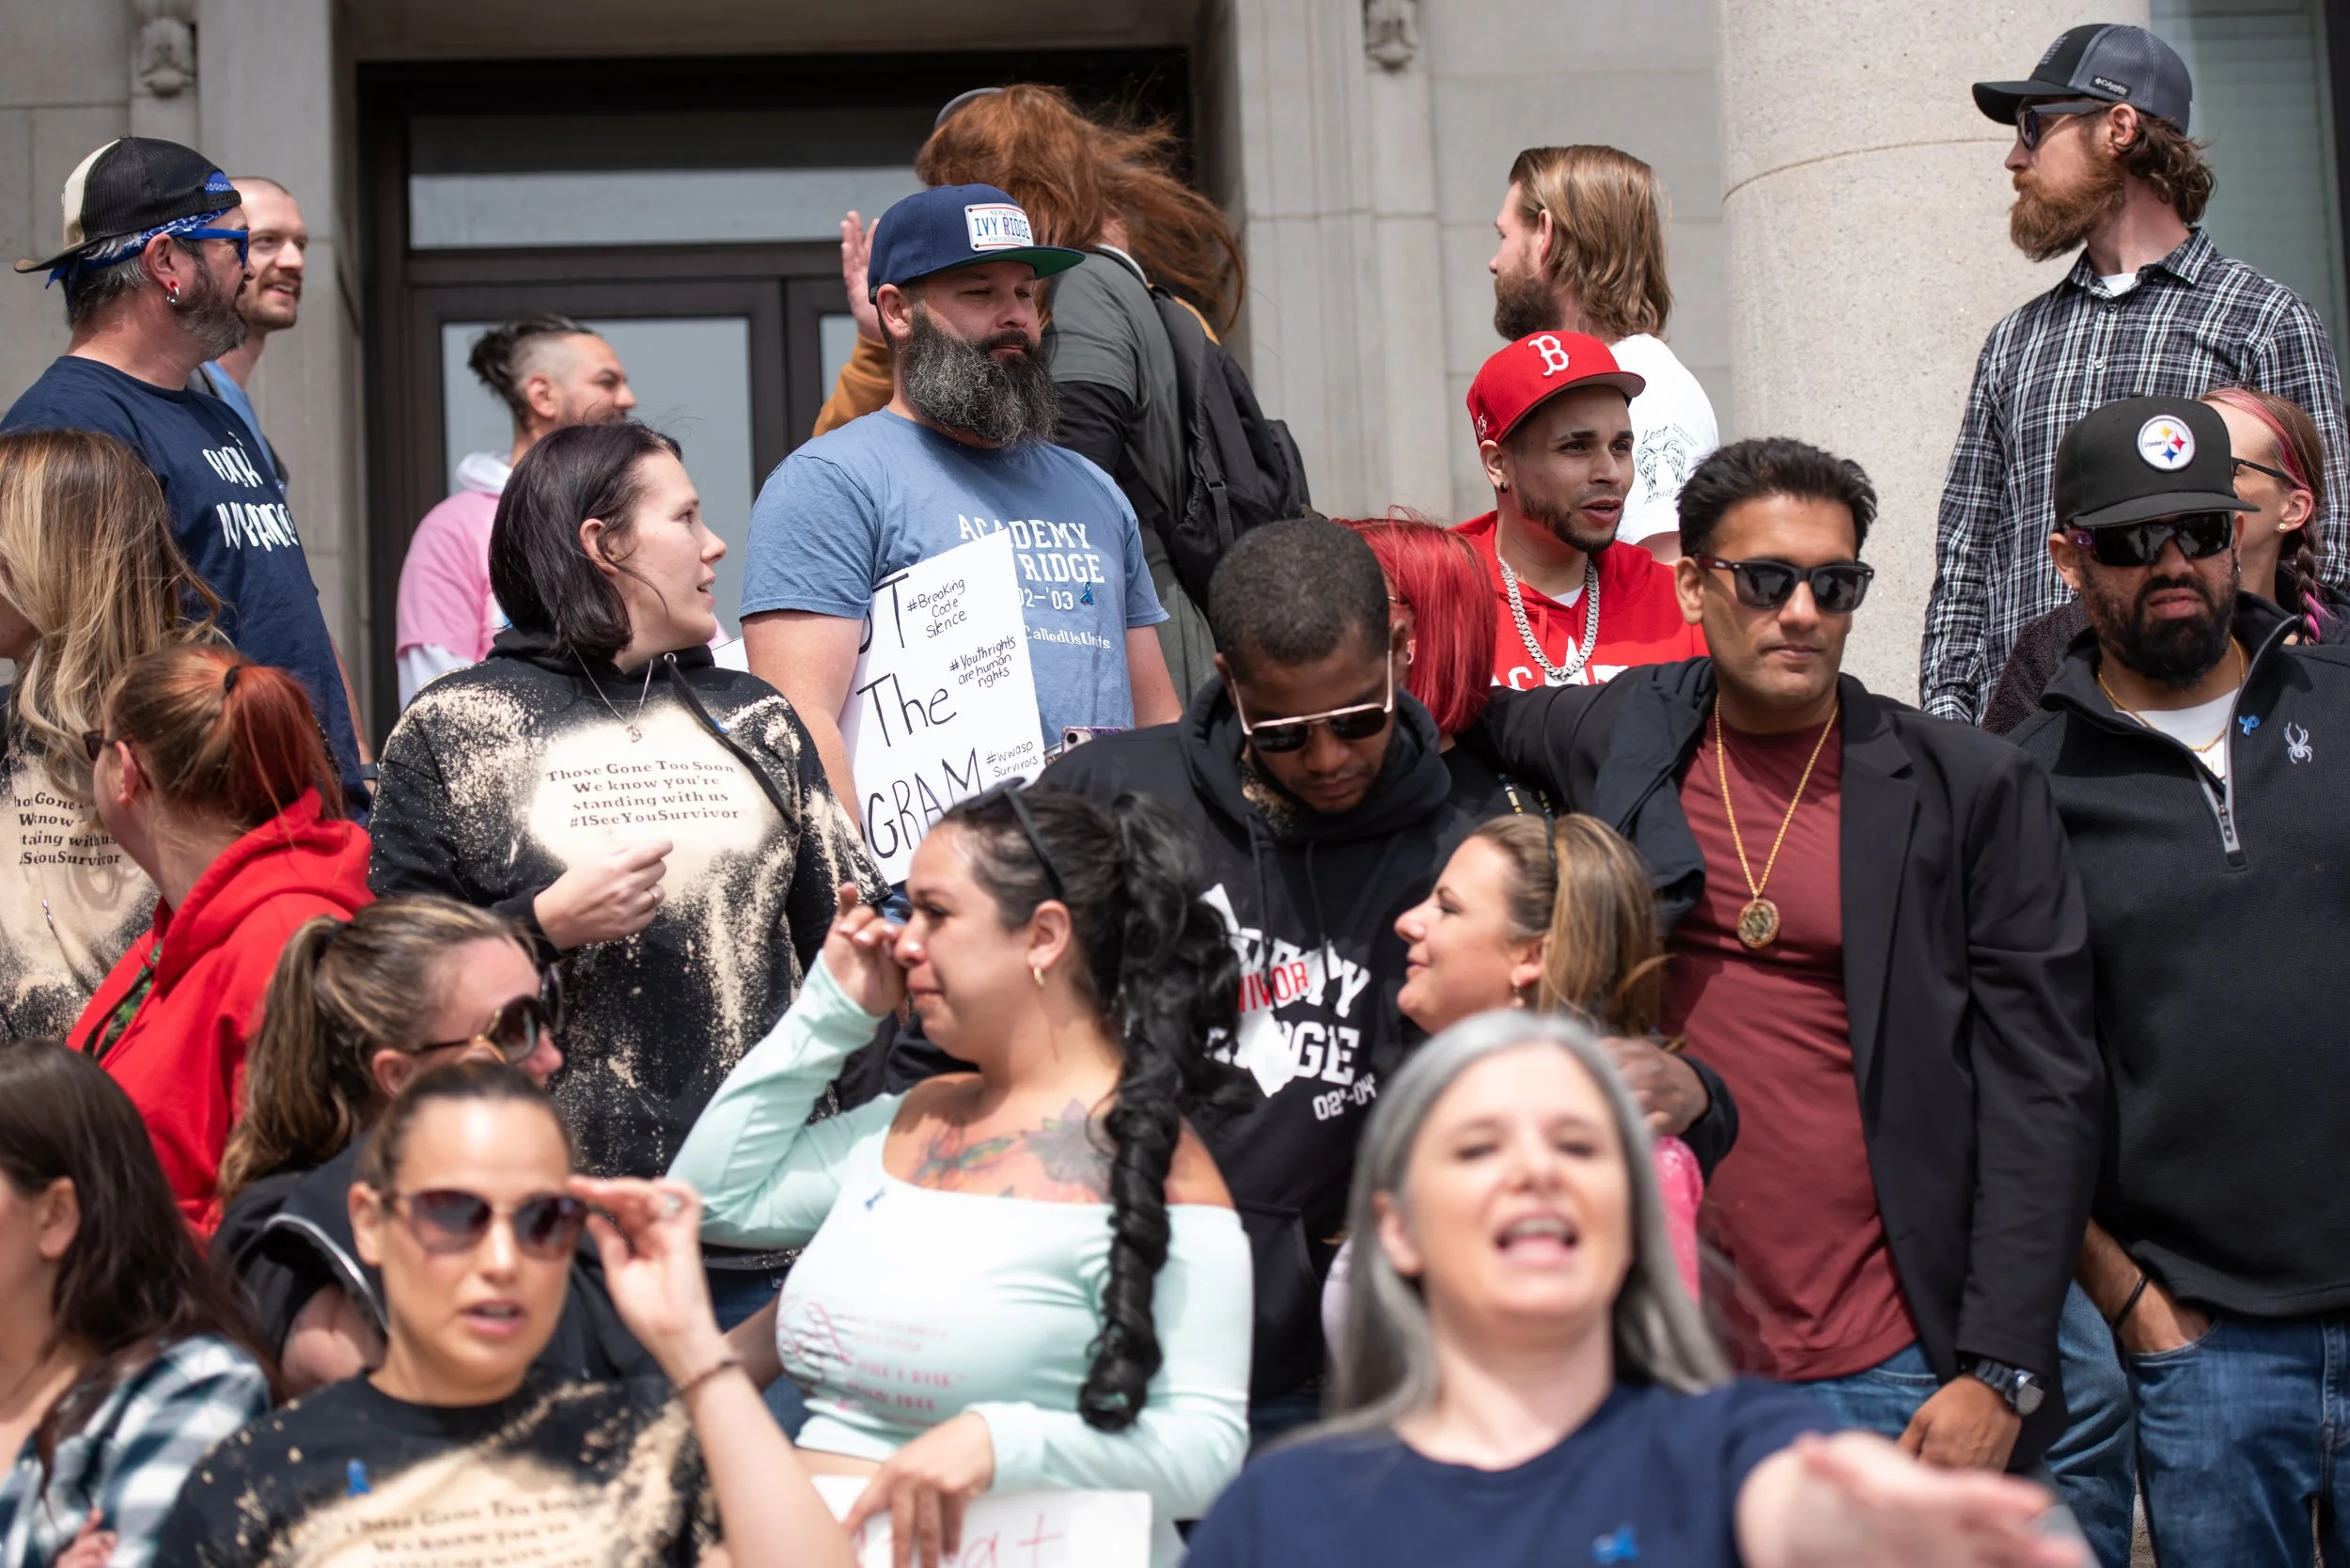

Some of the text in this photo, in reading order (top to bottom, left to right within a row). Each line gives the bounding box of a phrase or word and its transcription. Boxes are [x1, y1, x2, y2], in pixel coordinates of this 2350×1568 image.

[975, 217, 1030, 240] IVY RIDGE
[1528, 335, 1570, 376] B
[1017, 554, 1105, 583] RIDGE
[959, 654, 1012, 684] are human
[978, 666, 1010, 688] rights
[855, 672, 957, 747] The
[546, 760, 735, 782] Those Gone Too Soon
[572, 776, 719, 793] We know you're
[35, 792, 75, 811] Gone
[572, 792, 728, 810] standing with us
[860, 747, 983, 859] GRAM
[570, 808, 739, 827] #ISeeYouSurvivor
